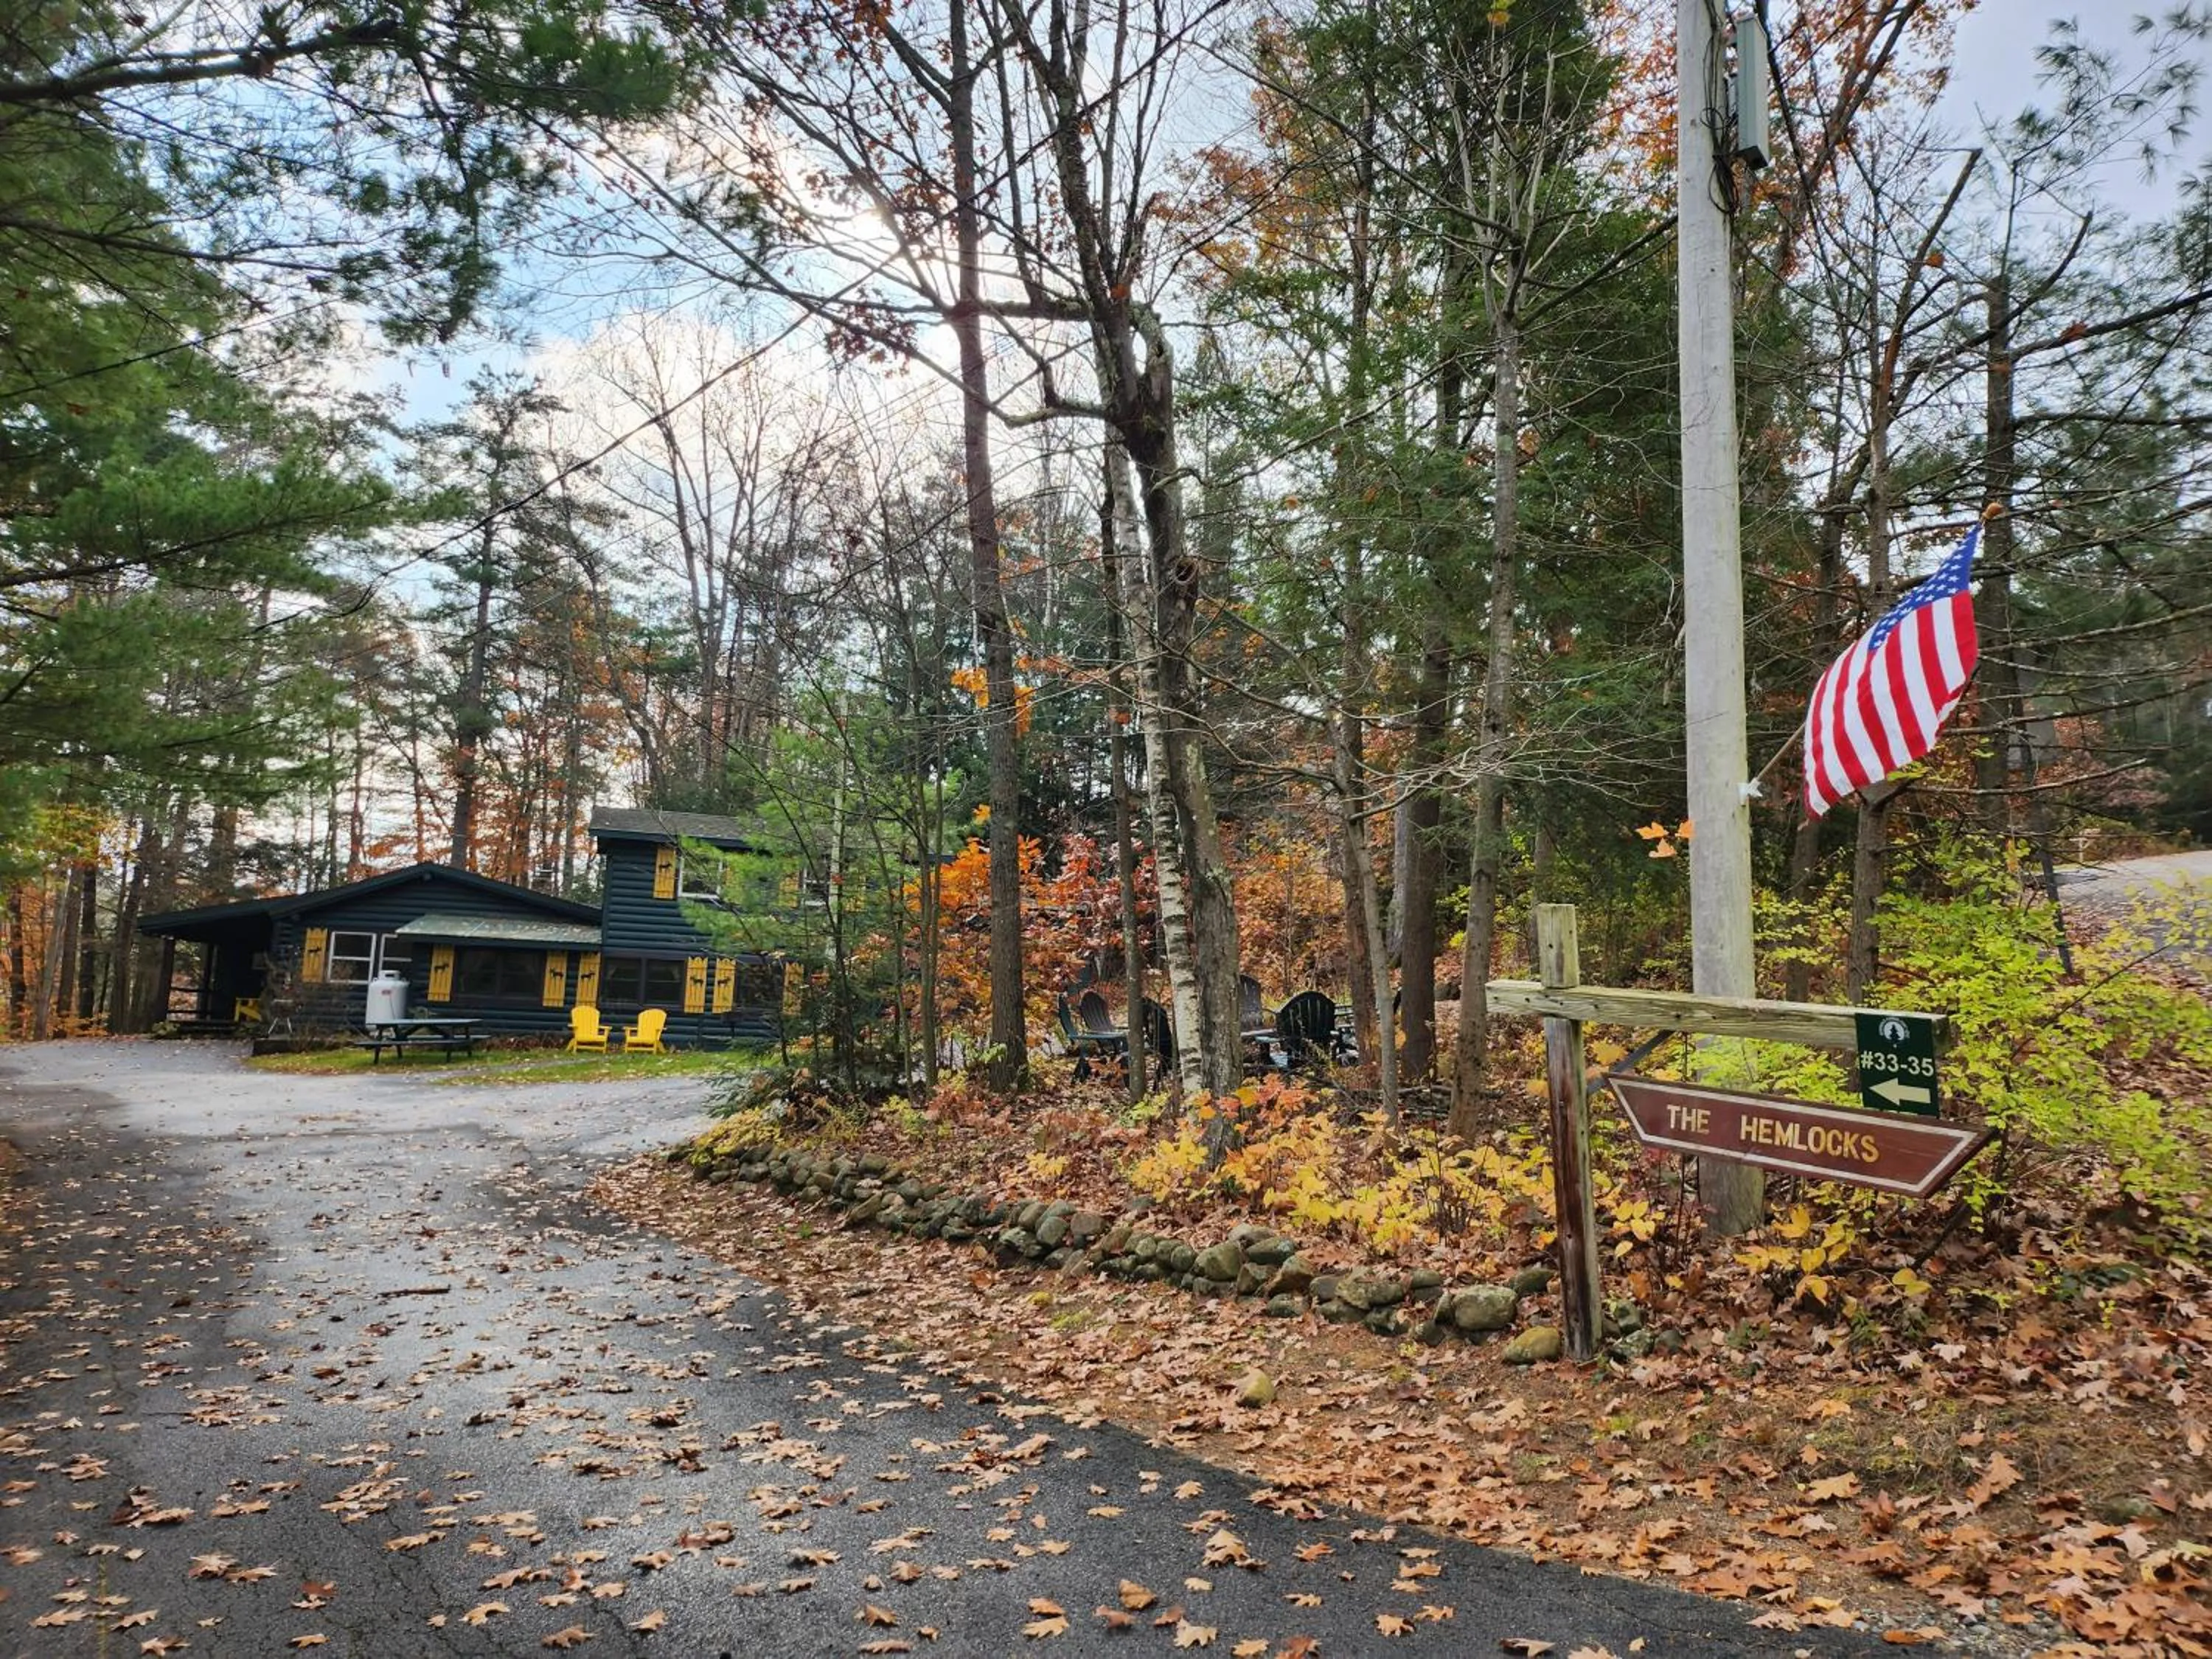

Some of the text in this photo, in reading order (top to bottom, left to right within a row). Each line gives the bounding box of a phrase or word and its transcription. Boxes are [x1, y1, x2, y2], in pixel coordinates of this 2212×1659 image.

[1861, 1050, 1934, 1077] #33-35
[1666, 1104, 1879, 1163] THE HEMLOCKS
